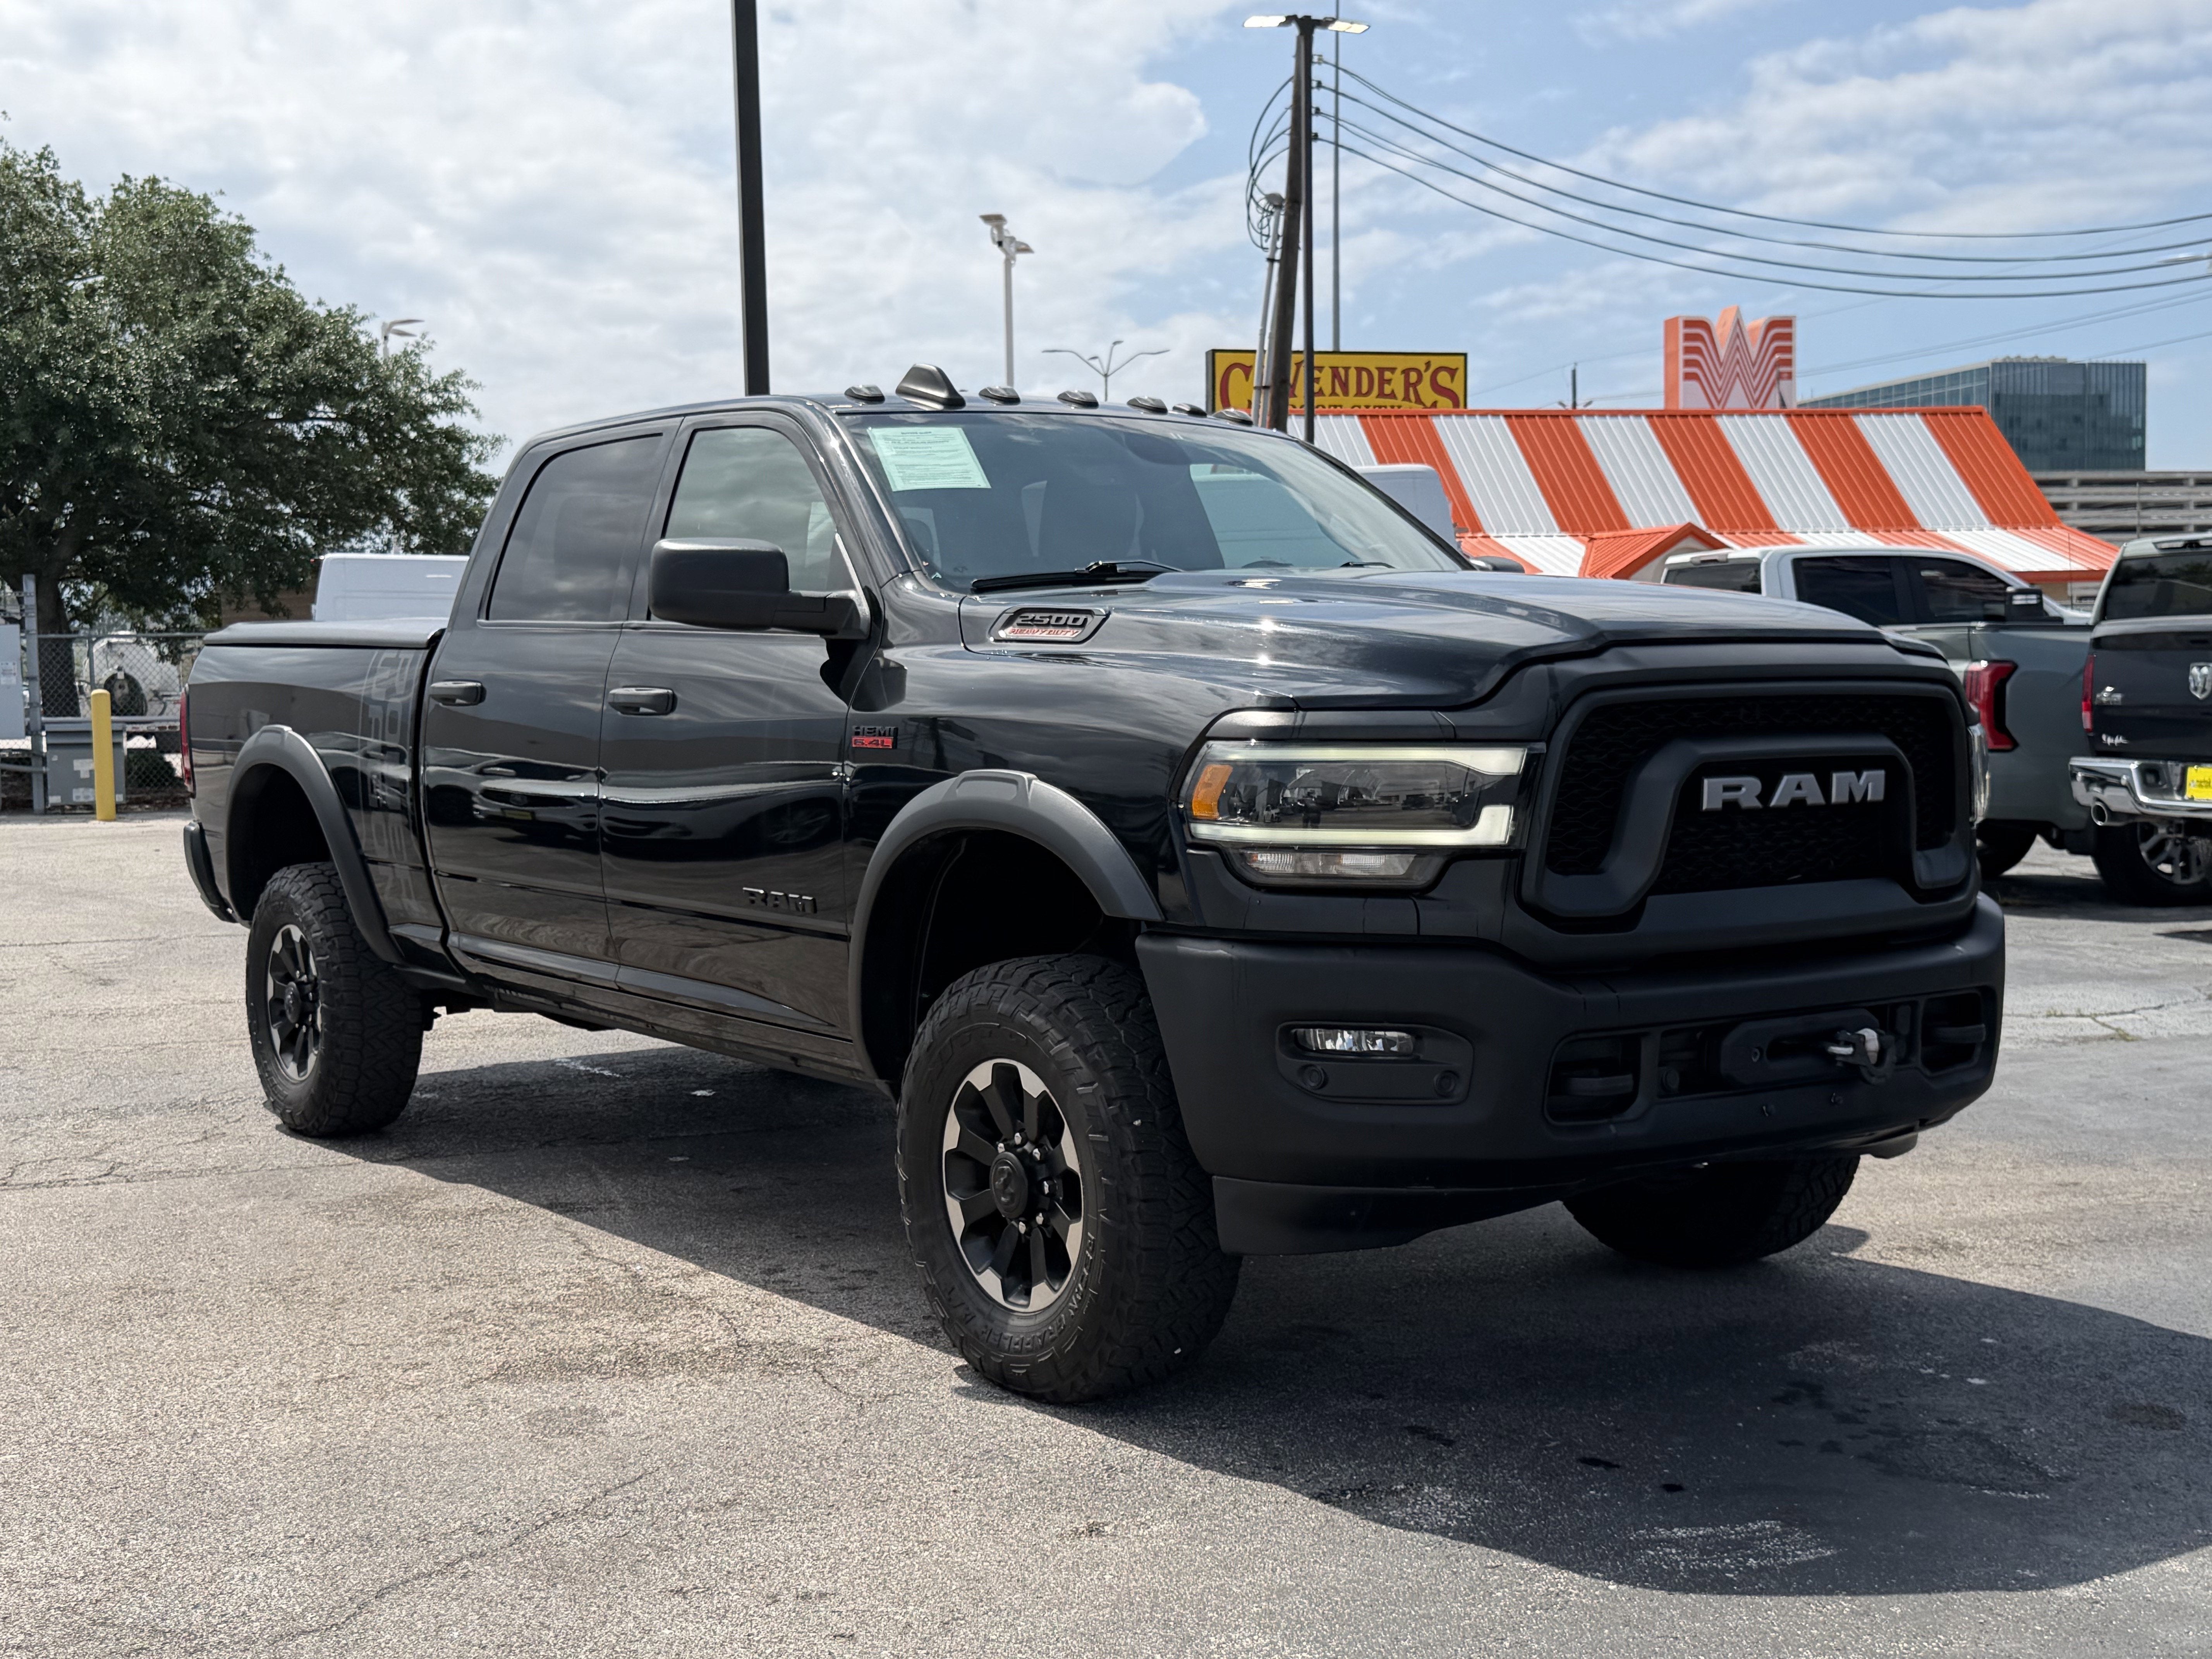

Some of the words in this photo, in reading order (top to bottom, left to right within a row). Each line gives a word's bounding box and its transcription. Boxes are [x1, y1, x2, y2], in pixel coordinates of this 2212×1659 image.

[1219, 360, 1460, 409] CVENDER'S
[1016, 614, 1088, 627] 2500
[852, 726, 894, 737] HEMI
[854, 738, 891, 747] 6.4L
[1702, 769, 1885, 811] RAM
[742, 887, 816, 913] RAM
